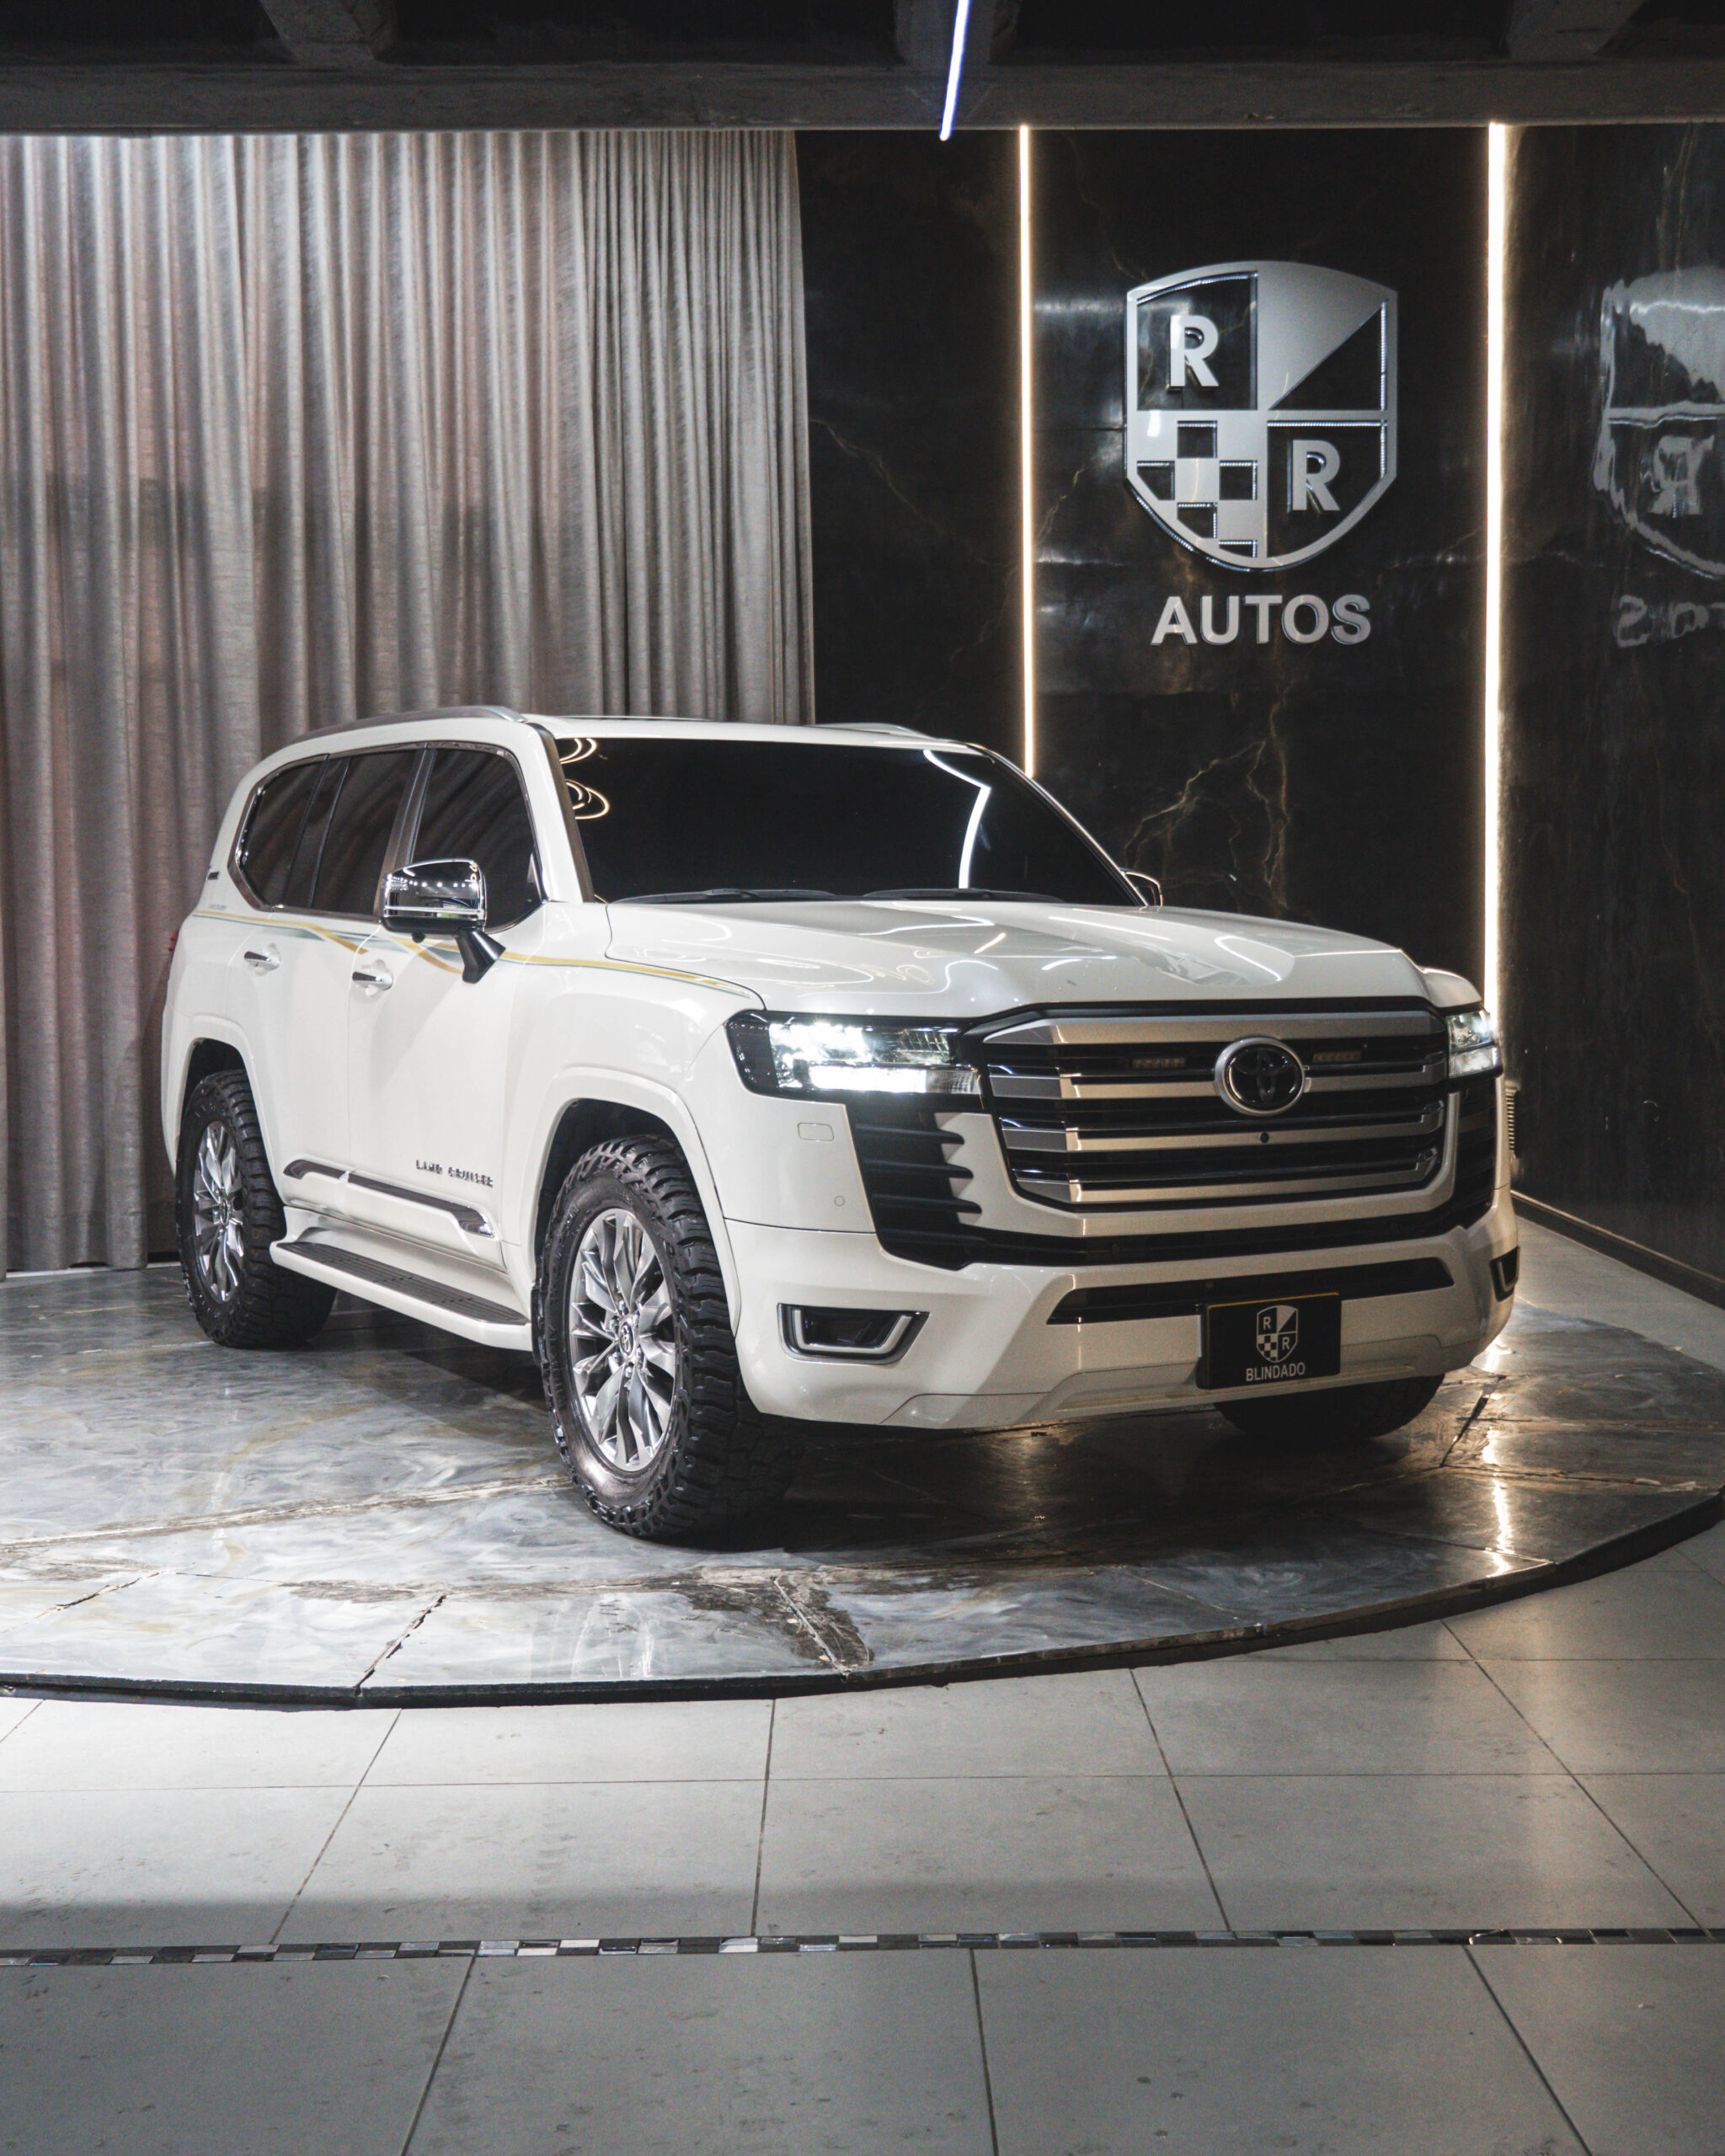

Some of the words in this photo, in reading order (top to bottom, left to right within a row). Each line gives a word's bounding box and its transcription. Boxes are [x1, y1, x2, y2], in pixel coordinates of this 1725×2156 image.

[1169, 314, 1220, 388] R
[1290, 439, 1341, 512] R
[1150, 594, 1372, 646] AUTOS
[415, 1160, 443, 1174] LAND
[1263, 1316, 1271, 1330] R
[1282, 1337, 1290, 1350] R
[1246, 1362, 1306, 1381] BLINDADO
